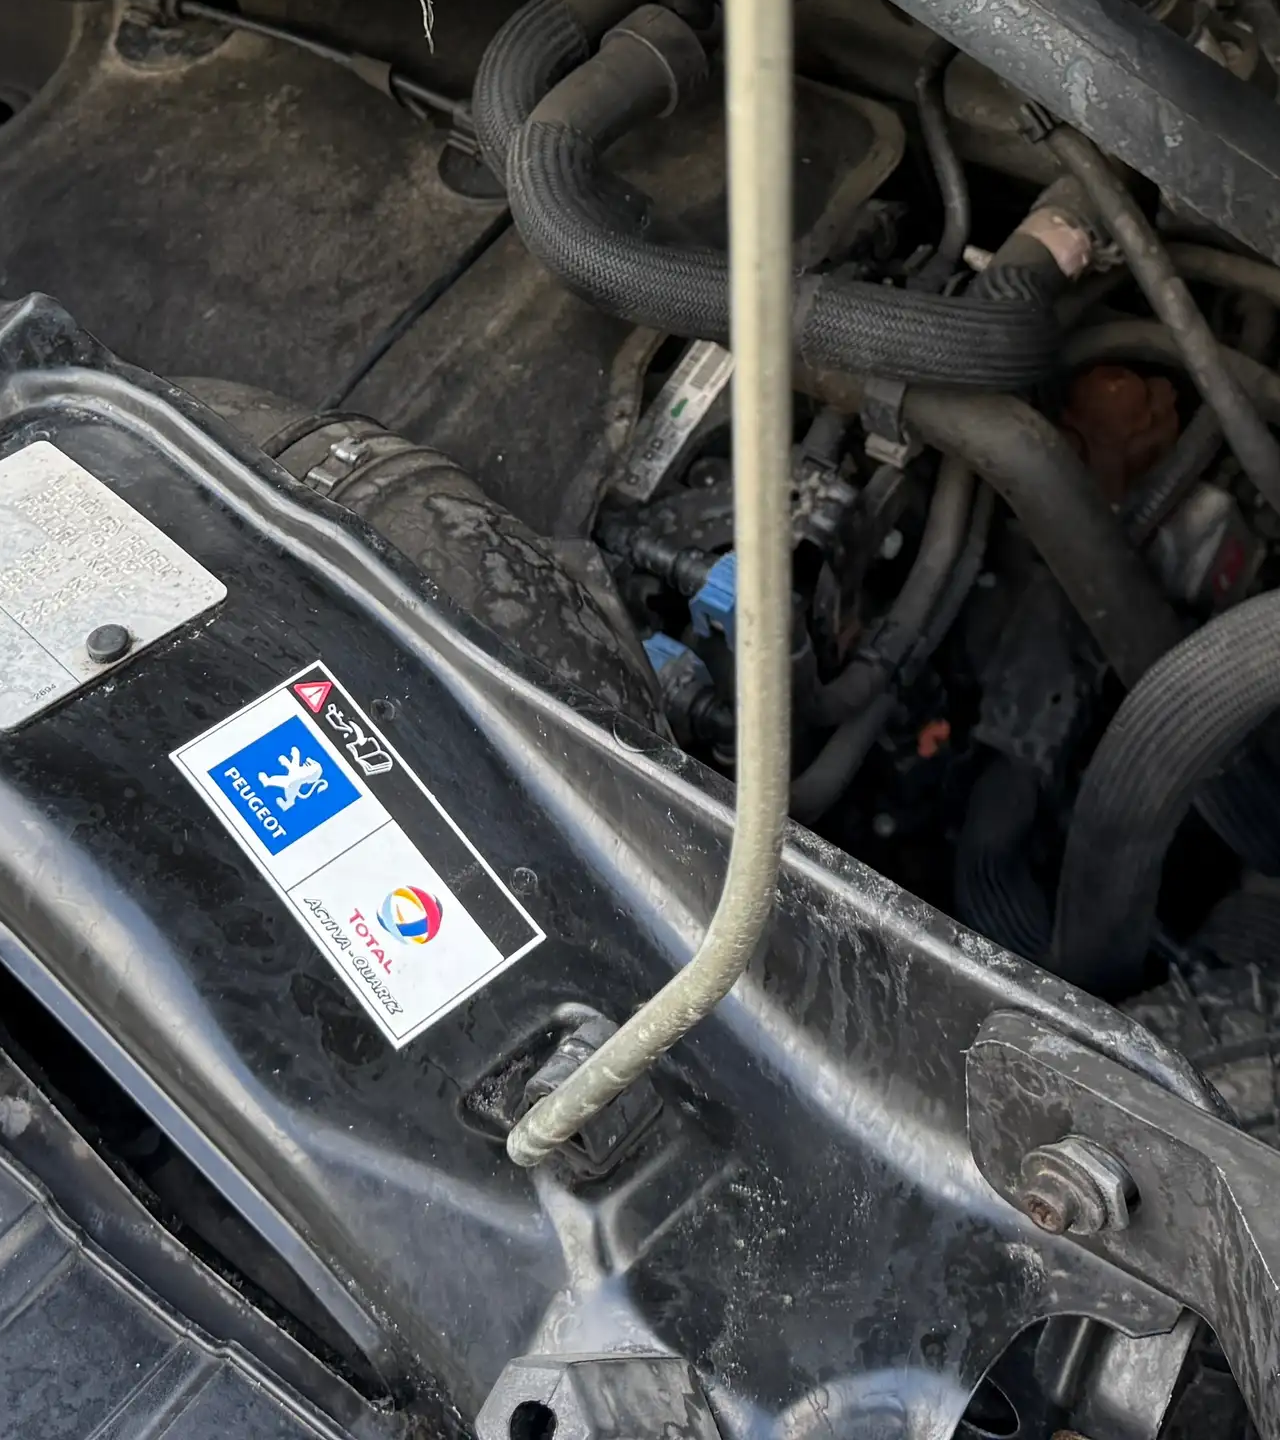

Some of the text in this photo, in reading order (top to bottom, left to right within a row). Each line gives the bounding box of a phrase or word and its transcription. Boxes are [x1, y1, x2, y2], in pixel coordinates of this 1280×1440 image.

[223, 766, 287, 840] PEUGEOT
[304, 897, 351, 953] ACTIVA
[351, 955, 404, 1015] QUARTZ
[348, 908, 393, 974] TOTAL
